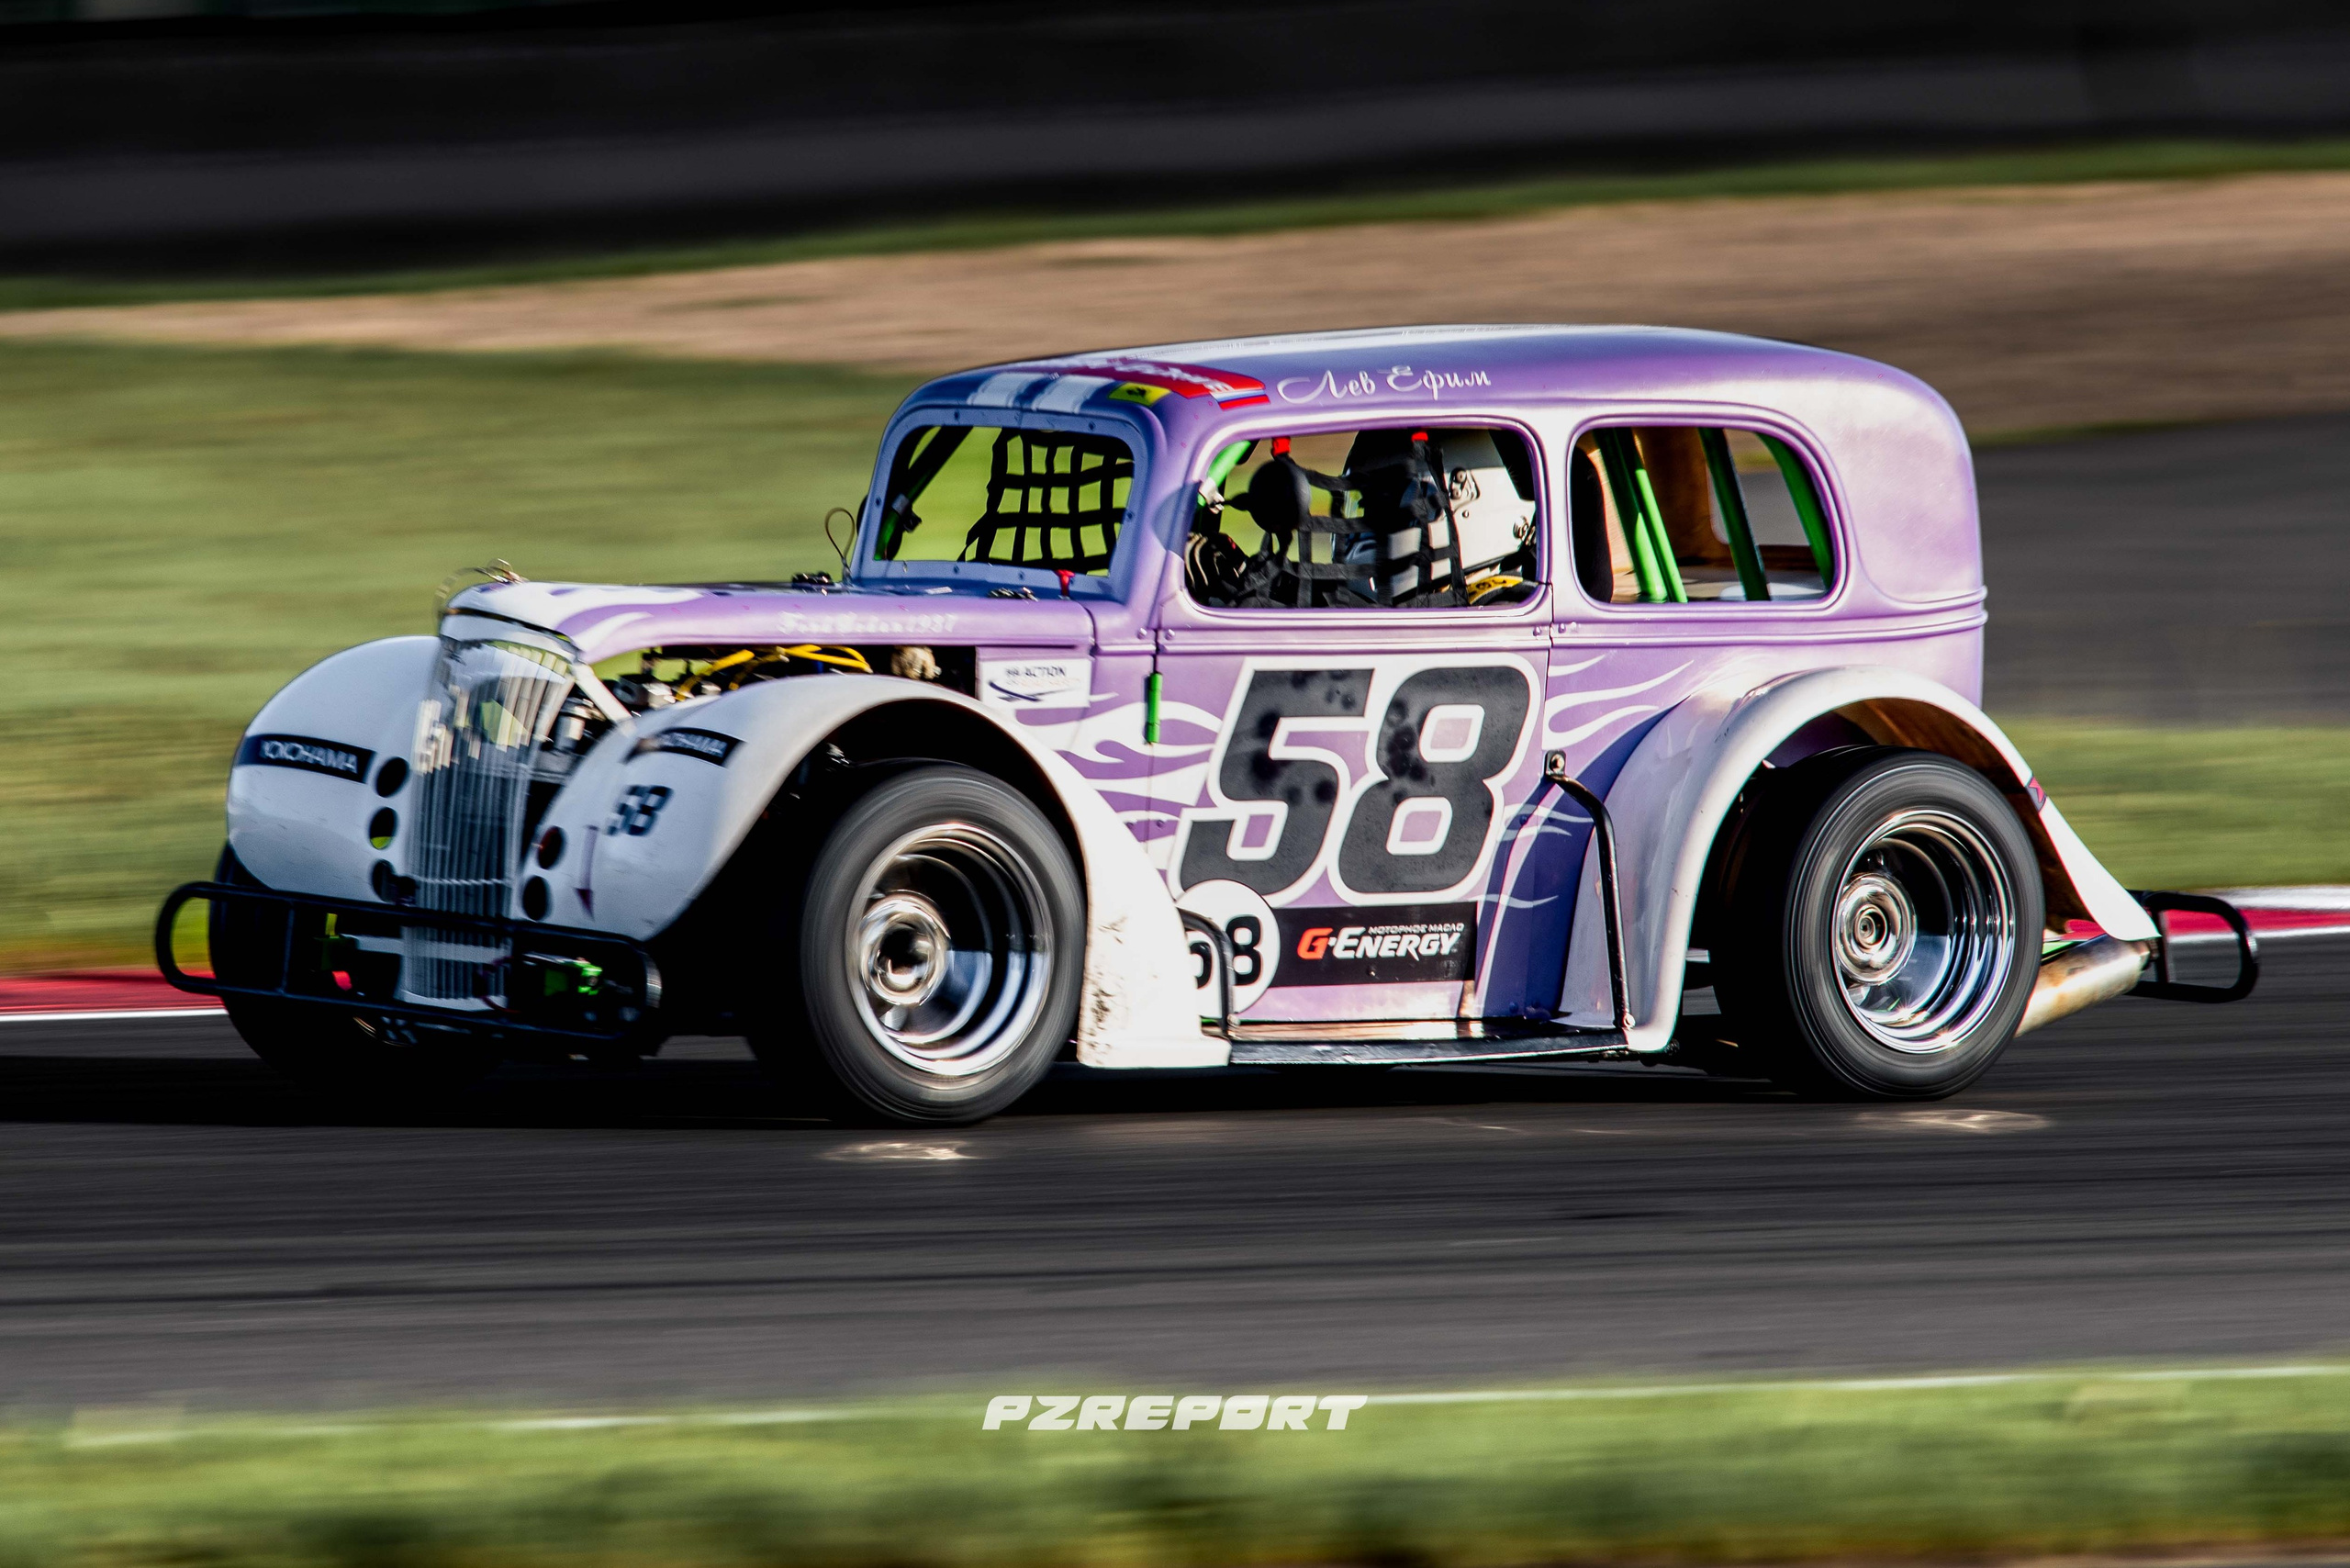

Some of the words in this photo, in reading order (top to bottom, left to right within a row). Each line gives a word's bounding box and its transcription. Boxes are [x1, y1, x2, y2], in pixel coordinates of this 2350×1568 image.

[1277, 369, 1375, 404] Лев
[1378, 364, 1492, 400] Ефим
[1178, 665, 1532, 896] 58
[603, 784, 674, 837] 58
